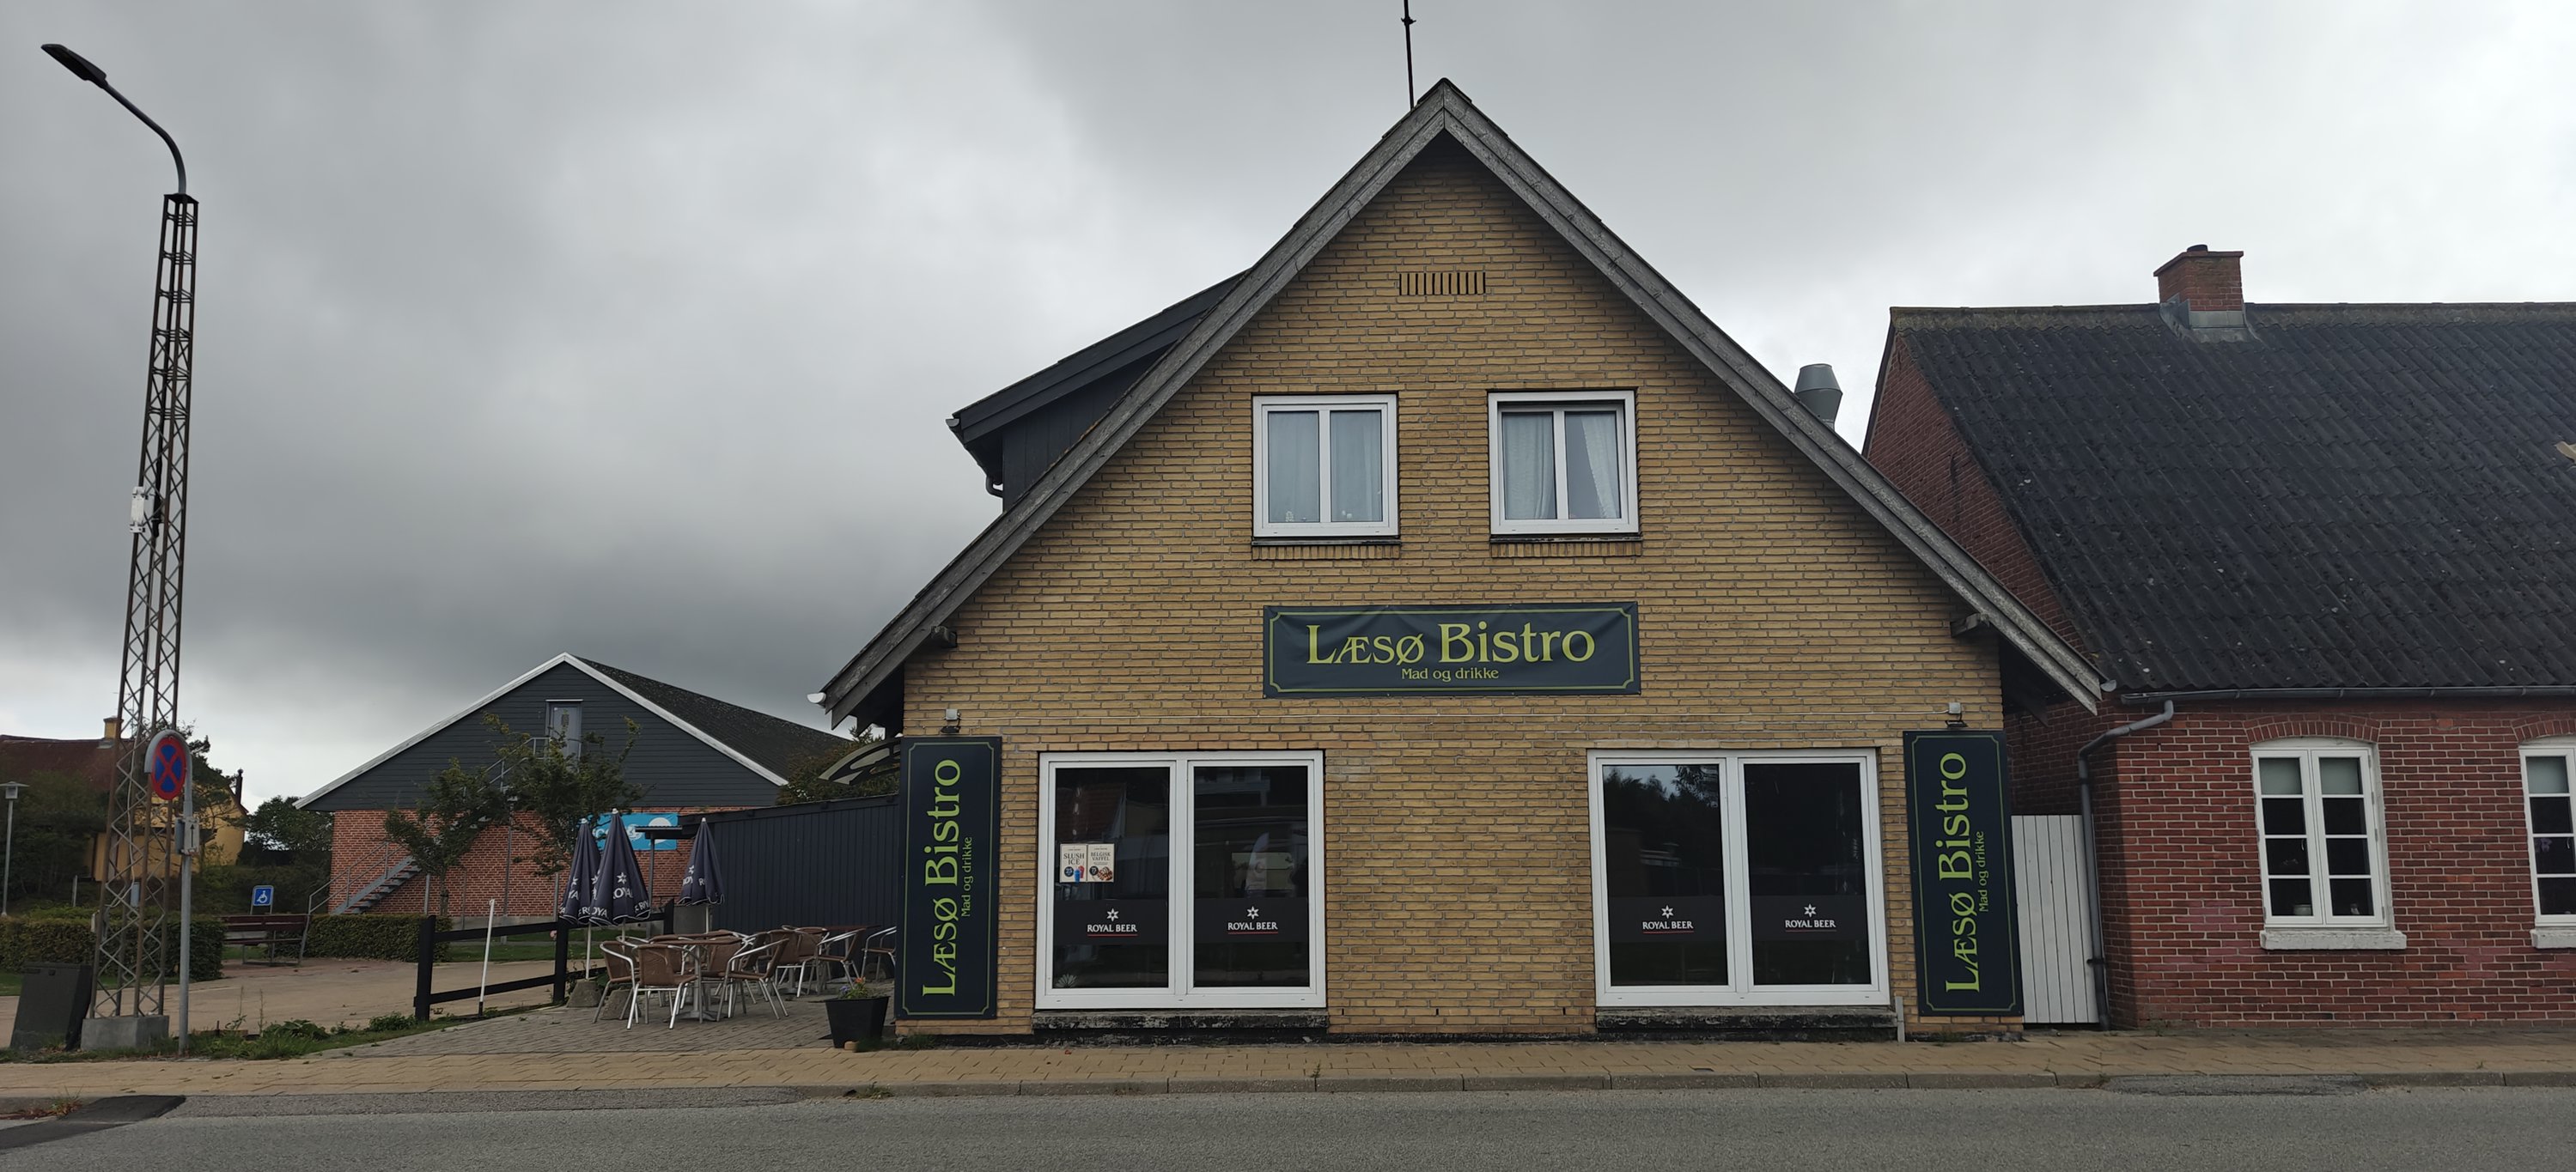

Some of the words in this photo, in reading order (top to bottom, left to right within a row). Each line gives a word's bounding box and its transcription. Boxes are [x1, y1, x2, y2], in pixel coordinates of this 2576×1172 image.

[1439, 621, 1596, 664] Bistro
[1401, 668, 1429, 680] Mad
[1432, 670, 1452, 682] og
[1454, 667, 1500, 679] drikke
[923, 758, 961, 887] Bistro
[1934, 751, 1973, 881] Bistro
[962, 836, 972, 874] drikke
[1976, 830, 1985, 868] drikke
[964, 876, 974, 891] og
[1979, 870, 1989, 885] og
[961, 894, 971, 916] Mad
[1978, 889, 1988, 913] Mad
[1115, 924, 1138, 932] BEER
[1642, 921, 1670, 930] ROYAL
[1671, 920, 1694, 929] BEER
[1785, 920, 1812, 928] ROYAL
[1814, 920, 1836, 928] BEER
